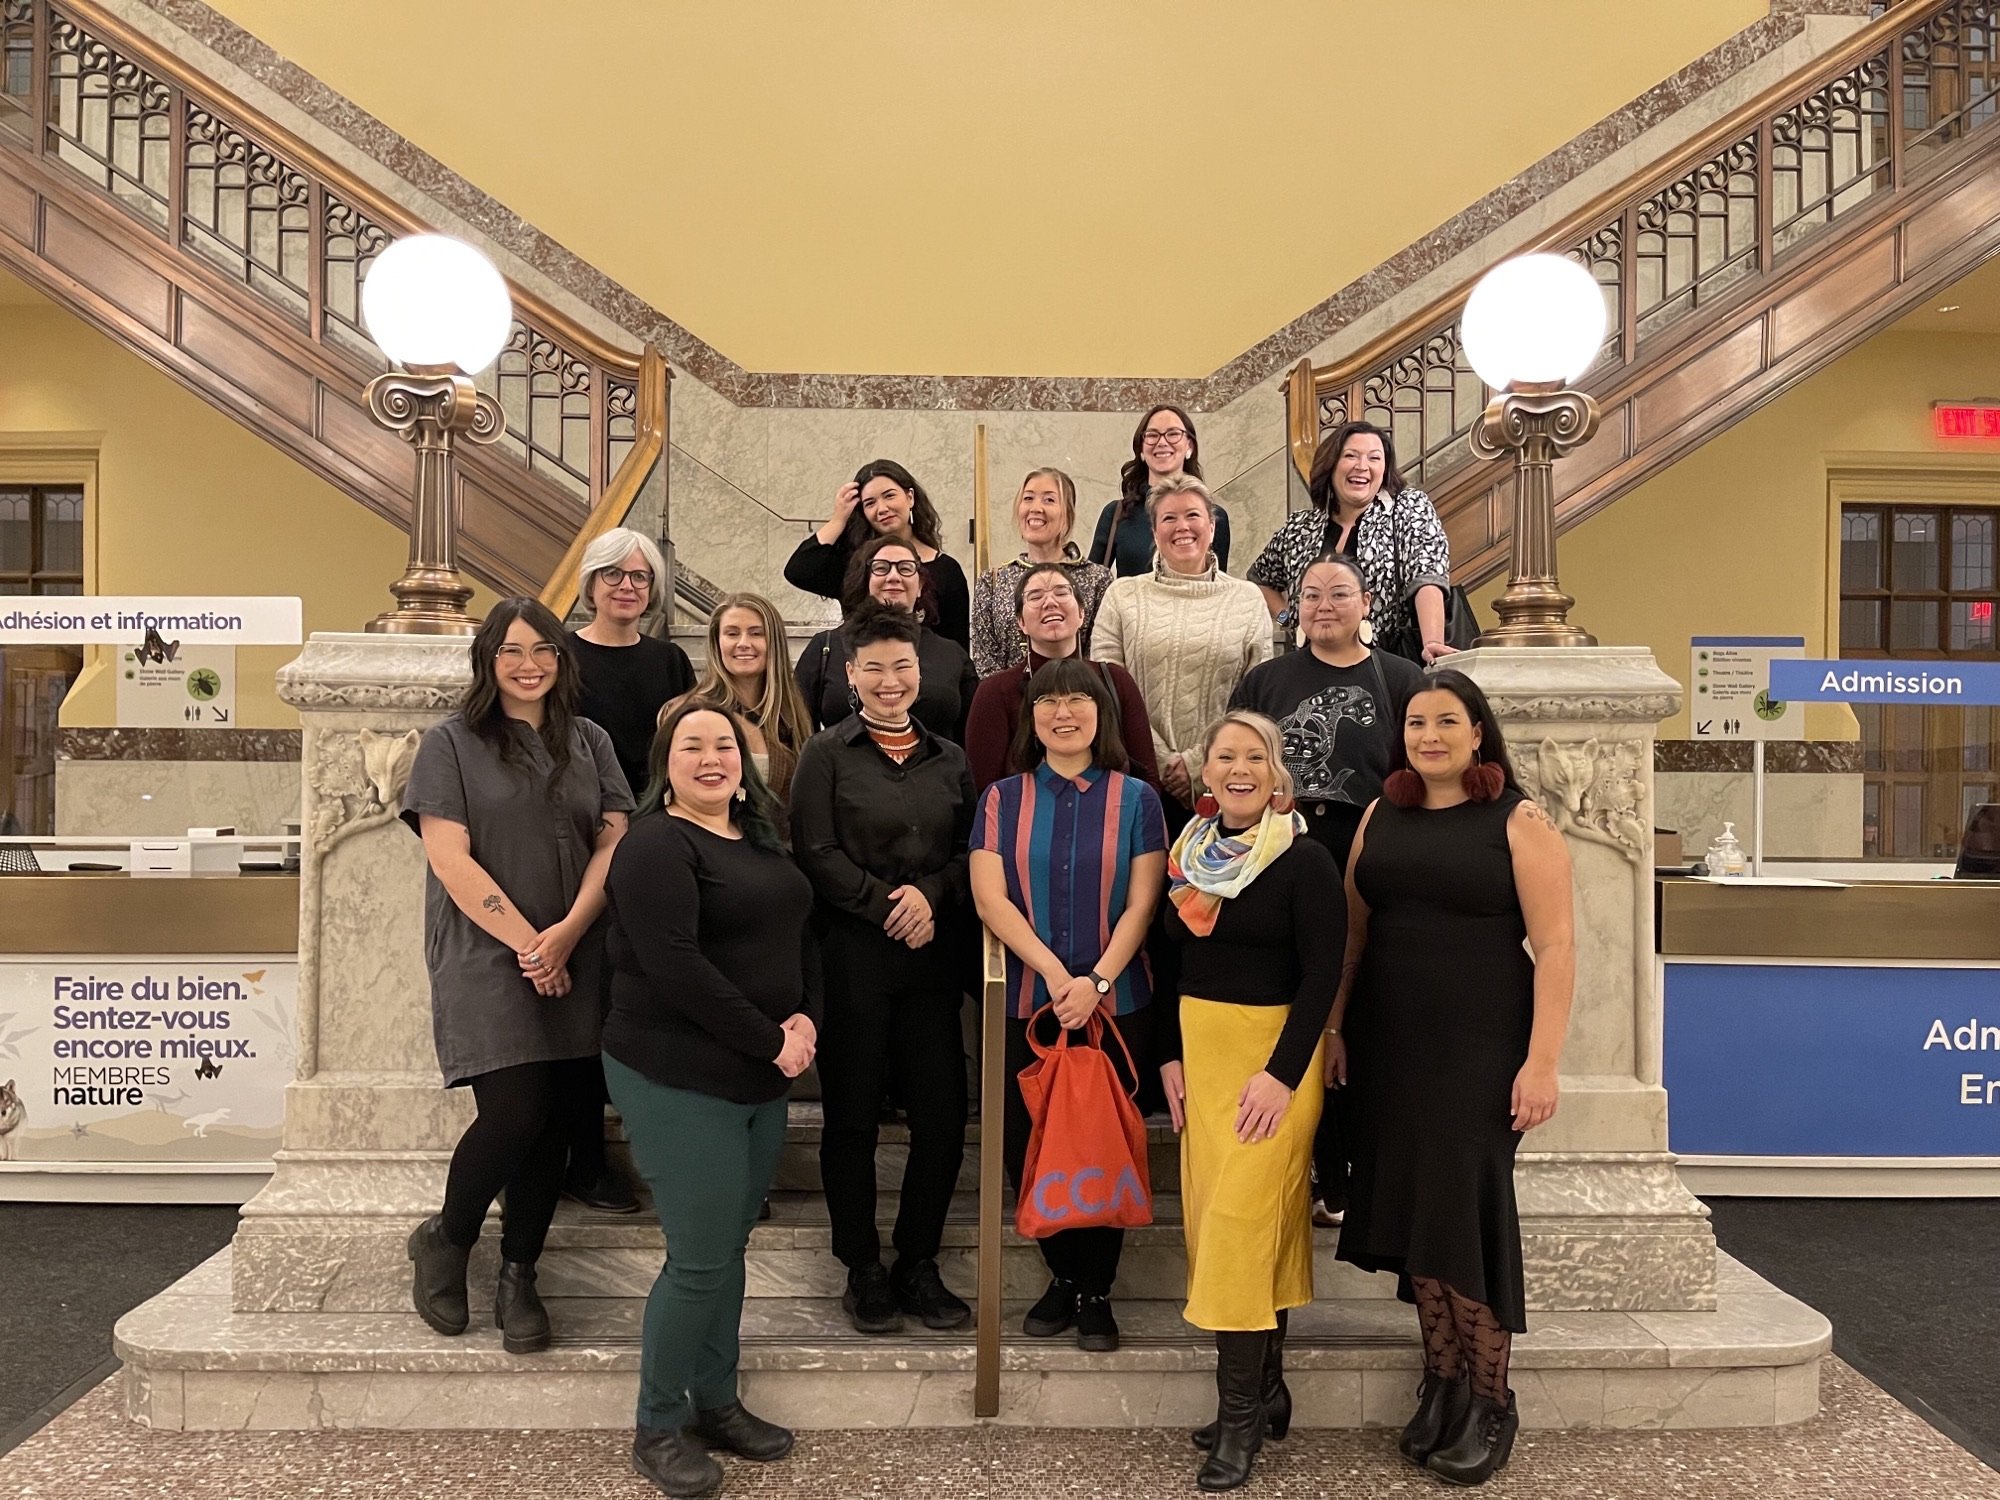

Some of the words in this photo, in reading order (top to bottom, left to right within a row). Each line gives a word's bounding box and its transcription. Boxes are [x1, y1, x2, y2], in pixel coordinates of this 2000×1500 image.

[1943, 409, 1976, 435] EXIT
[91, 613, 112, 630] et
[118, 611, 242, 630] information
[1820, 670, 1962, 694] Admission
[54, 976, 124, 1000] Faire
[131, 975, 170, 1000] du
[177, 975, 248, 1001] bien.
[53, 1005, 231, 1030] Sentez-vous
[53, 1039, 153, 1059] encore
[160, 1034, 257, 1059] mieux.
[54, 1066, 171, 1085] MEMBRES
[54, 1085, 144, 1106] nature
[1033, 1164, 1146, 1221] CCA
